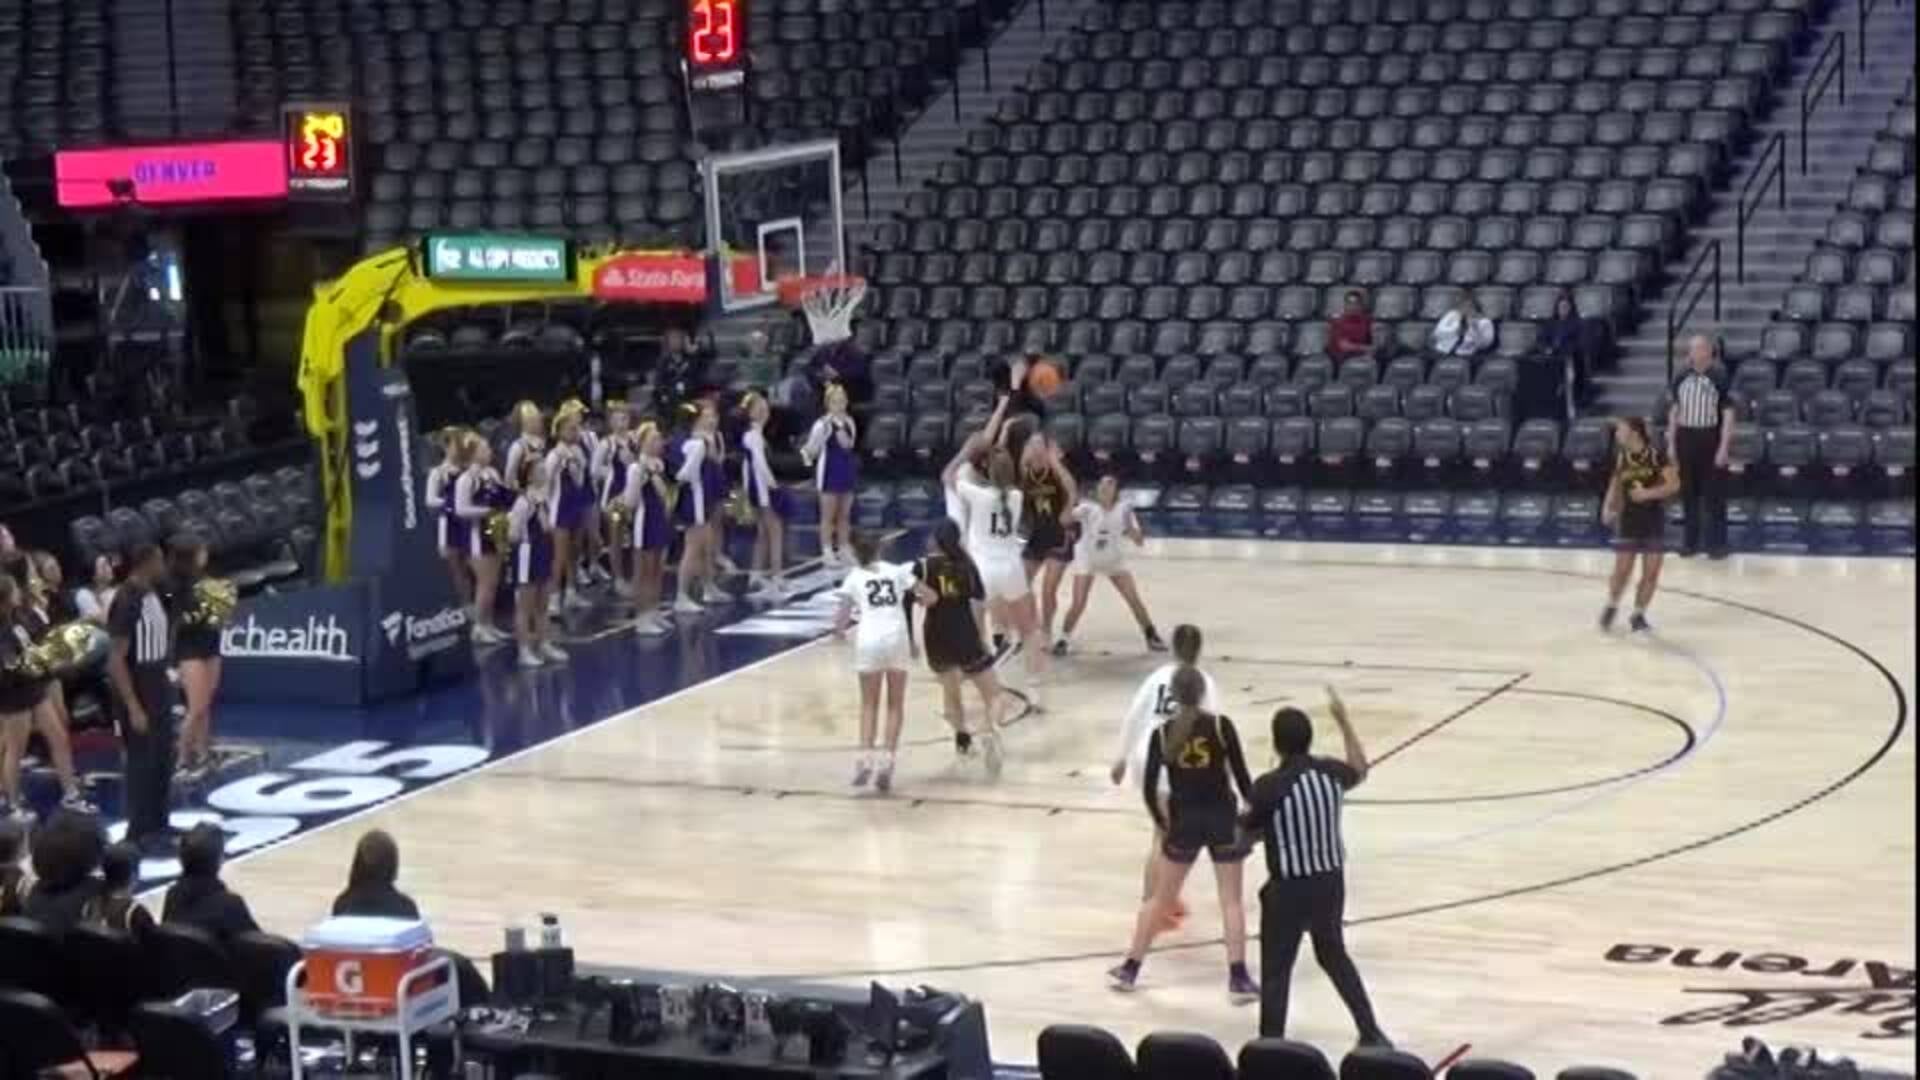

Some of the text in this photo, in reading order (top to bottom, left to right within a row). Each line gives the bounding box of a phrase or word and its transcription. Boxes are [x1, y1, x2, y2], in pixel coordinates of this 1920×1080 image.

[693, 0, 734, 60] 23
[303, 137, 337, 169] 23
[135, 160, 216, 184] DENVER
[626, 268, 668, 288] State
[865, 579, 897, 605] 23
[335, 960, 364, 994] G
